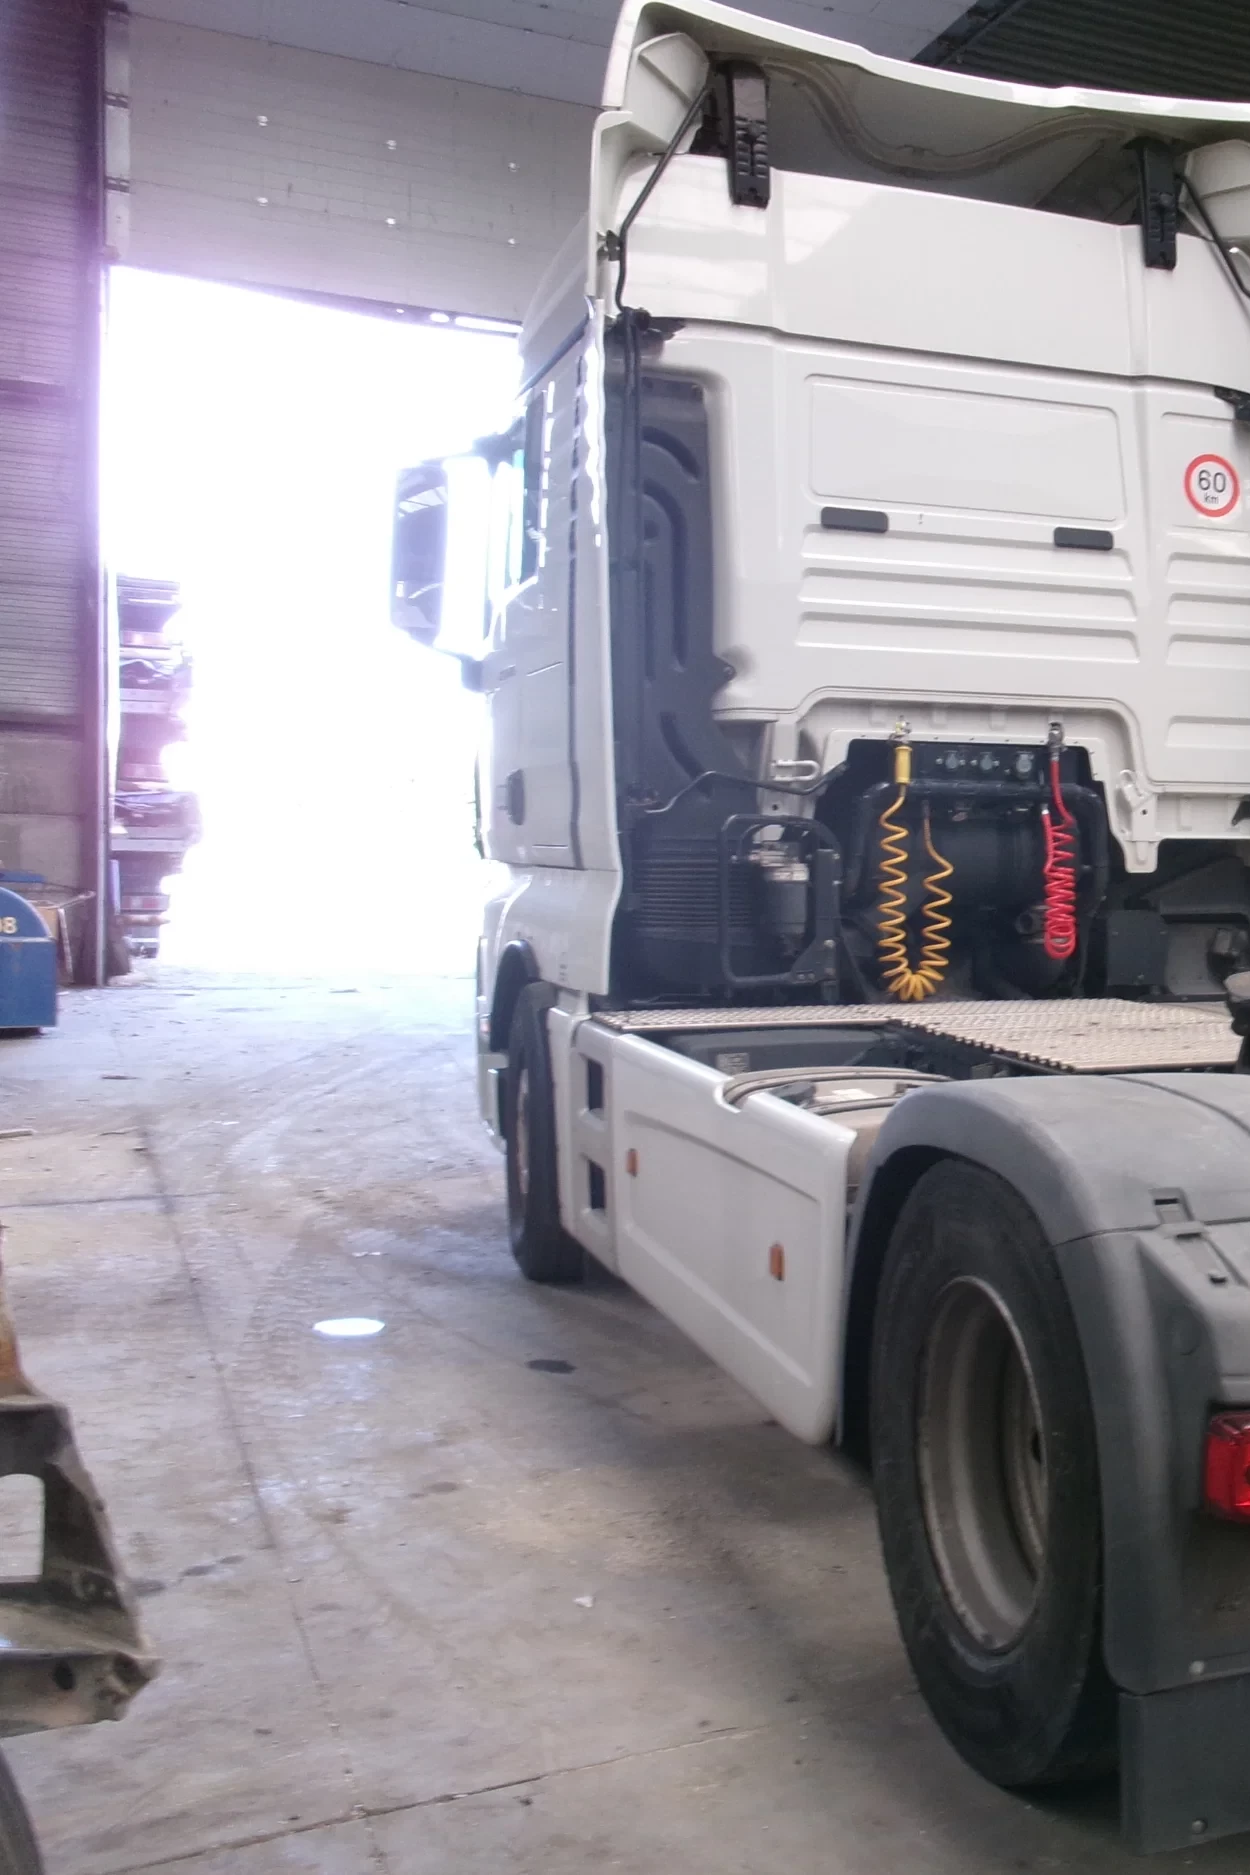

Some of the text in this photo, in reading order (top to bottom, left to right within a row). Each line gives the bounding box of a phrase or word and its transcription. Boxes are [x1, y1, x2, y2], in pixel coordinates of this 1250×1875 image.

[1198, 469, 1226, 493] 60
[1204, 492, 1219, 504] km
[0, 916, 17, 934] 8
